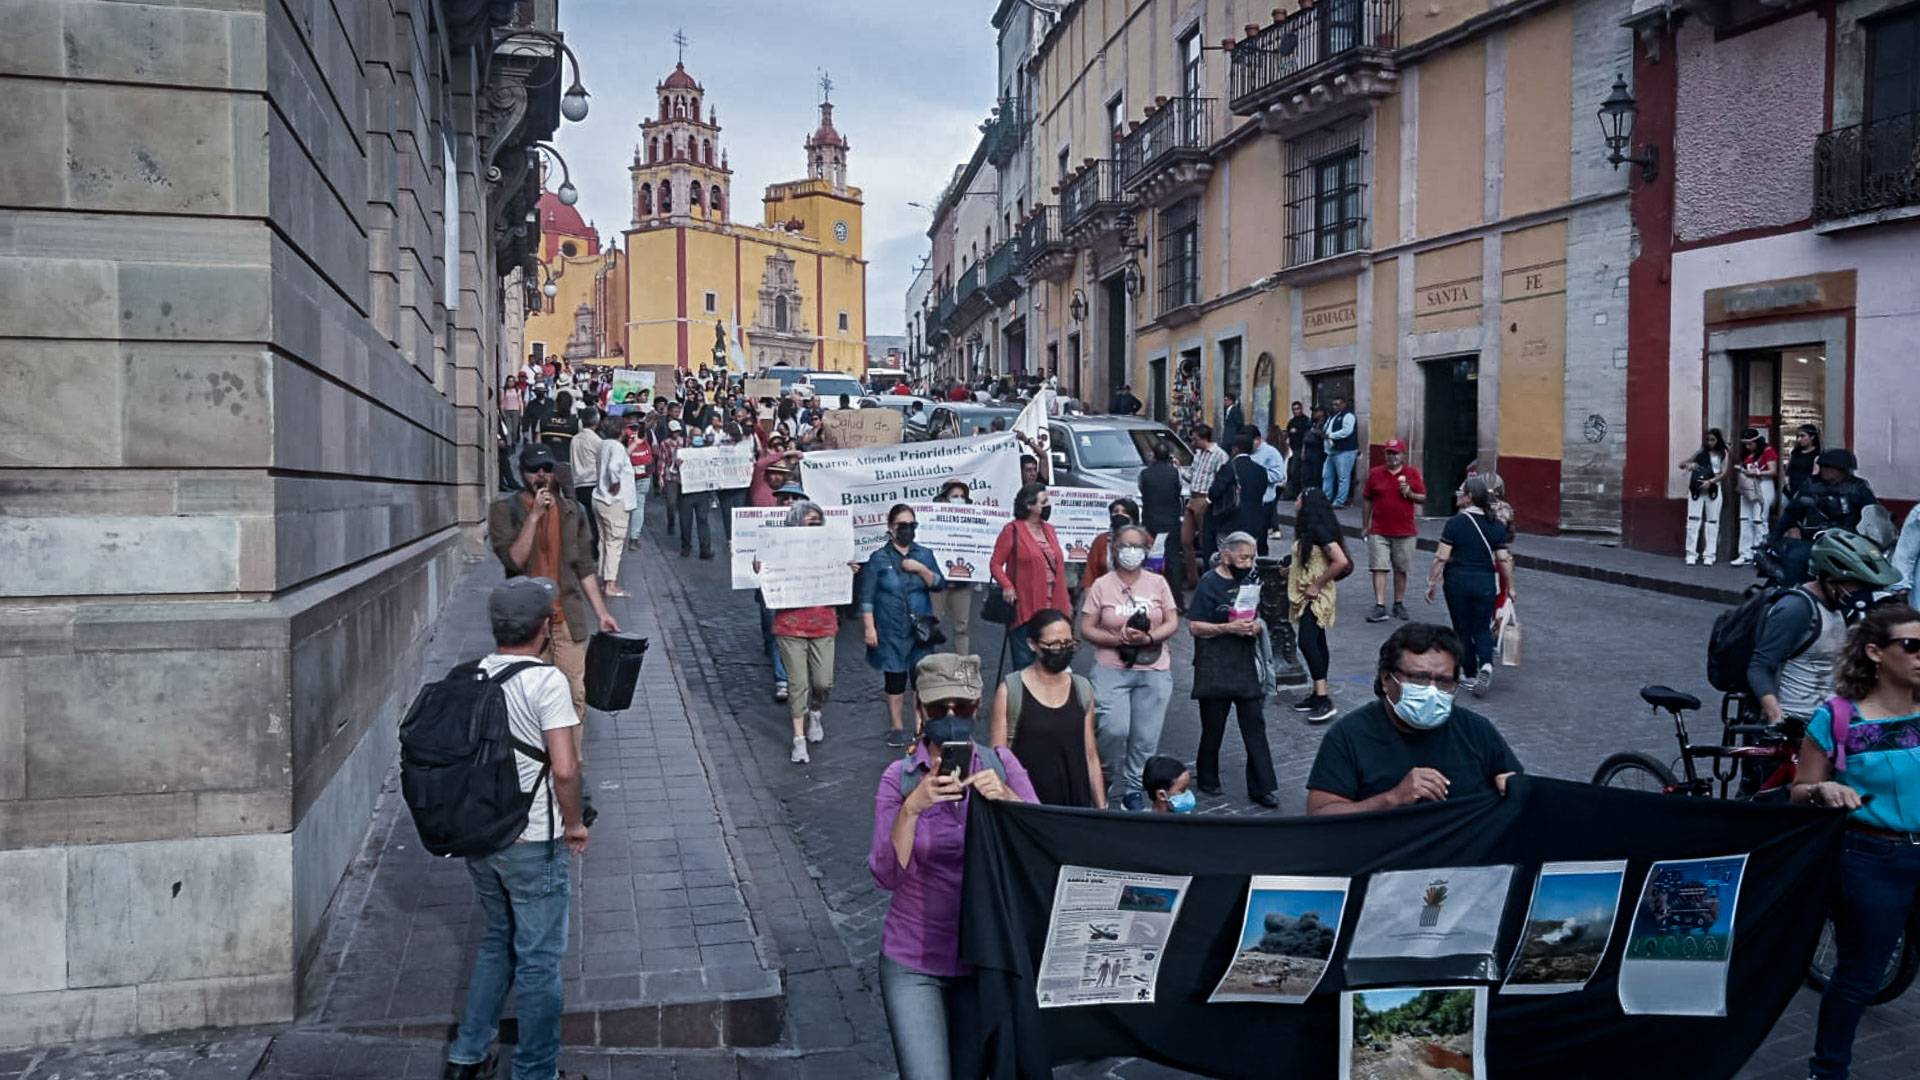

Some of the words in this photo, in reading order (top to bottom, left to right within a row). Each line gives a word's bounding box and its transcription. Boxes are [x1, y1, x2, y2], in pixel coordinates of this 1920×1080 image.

[1305, 309, 1356, 328] FARMACIA
[1426, 287, 1469, 306] SANTA
[1526, 273, 1543, 291] FE
[829, 411, 865, 431] Salud
[856, 452, 897, 466] Atiende
[875, 463, 954, 481] Banalidades
[841, 486, 898, 505] Basura
